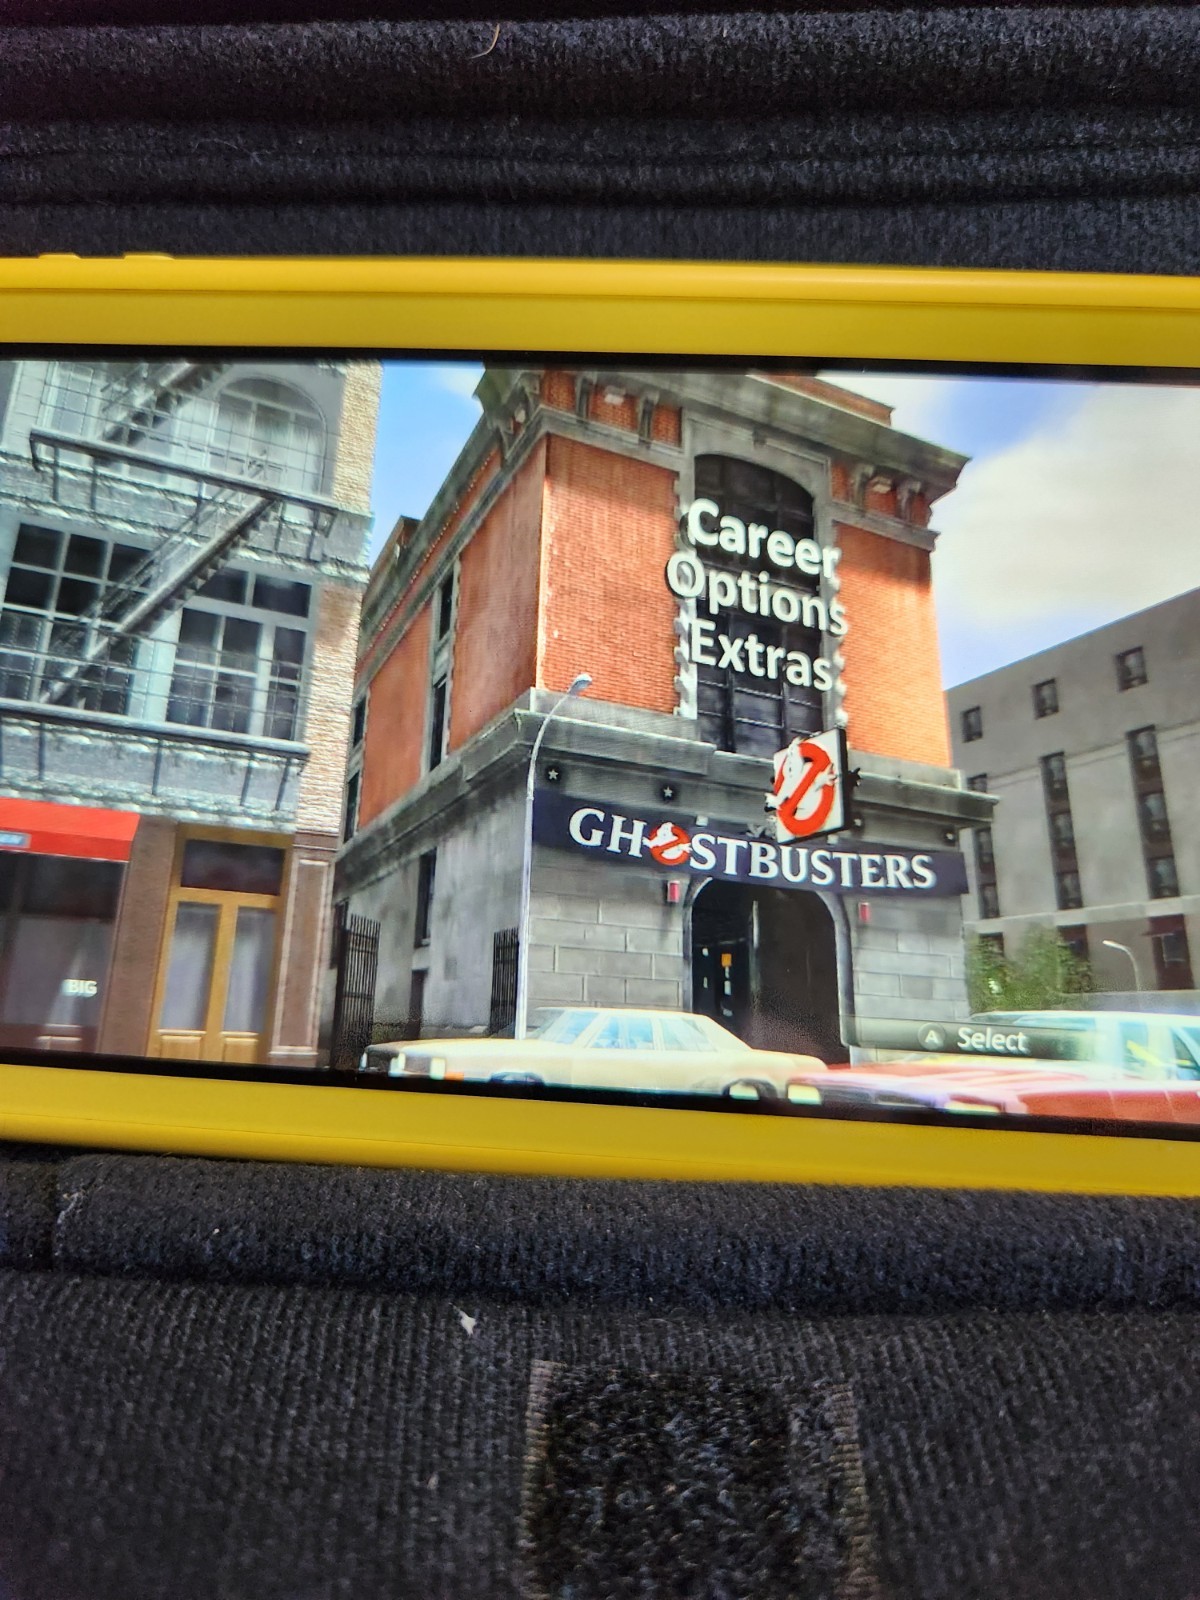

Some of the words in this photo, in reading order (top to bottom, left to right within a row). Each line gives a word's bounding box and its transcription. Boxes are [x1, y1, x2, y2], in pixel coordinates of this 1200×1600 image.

[687, 498, 842, 578] Career
[665, 551, 849, 636] Options
[690, 618, 833, 691] Extras
[957, 1026, 1029, 1055] Select
